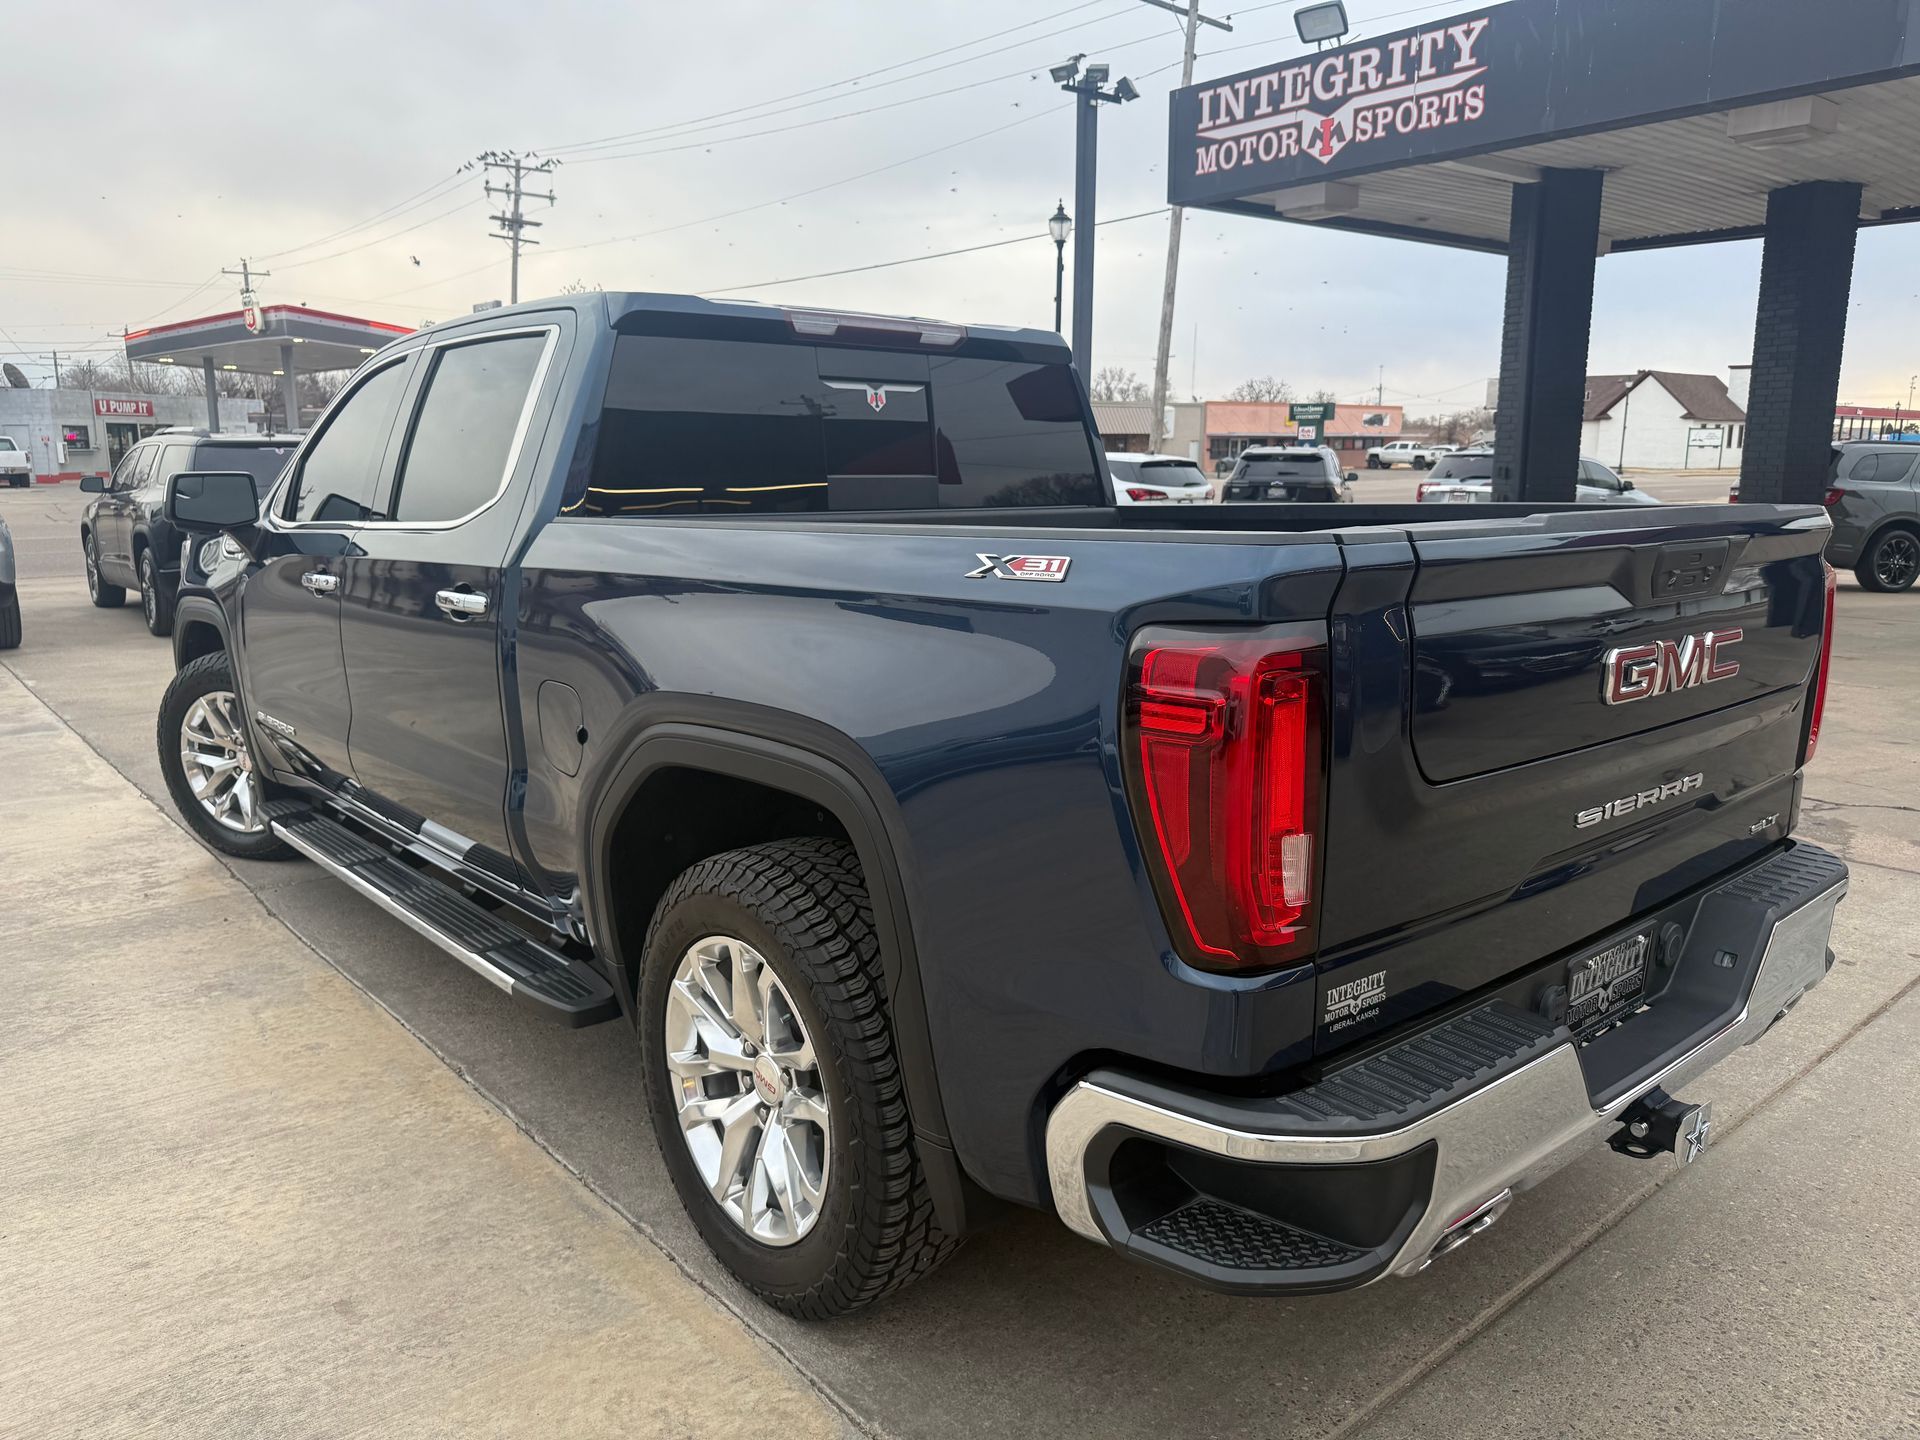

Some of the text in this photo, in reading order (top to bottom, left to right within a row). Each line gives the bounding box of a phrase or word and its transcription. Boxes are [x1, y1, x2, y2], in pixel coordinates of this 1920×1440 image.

[1197, 17, 1489, 130] INTEGRITY
[1195, 85, 1485, 176] MOTOR SPORTS
[99, 400, 107, 412] U
[109, 401, 137, 413] PUMP
[964, 553, 1066, 579] X31
[1601, 627, 1743, 706] GMC
[1574, 772, 1704, 829] SIERRA
[1749, 812, 1780, 835] SLT
[1326, 970, 1387, 1007] INTEGRITY
[1324, 991, 1387, 1024] MOTOR SPORTS
